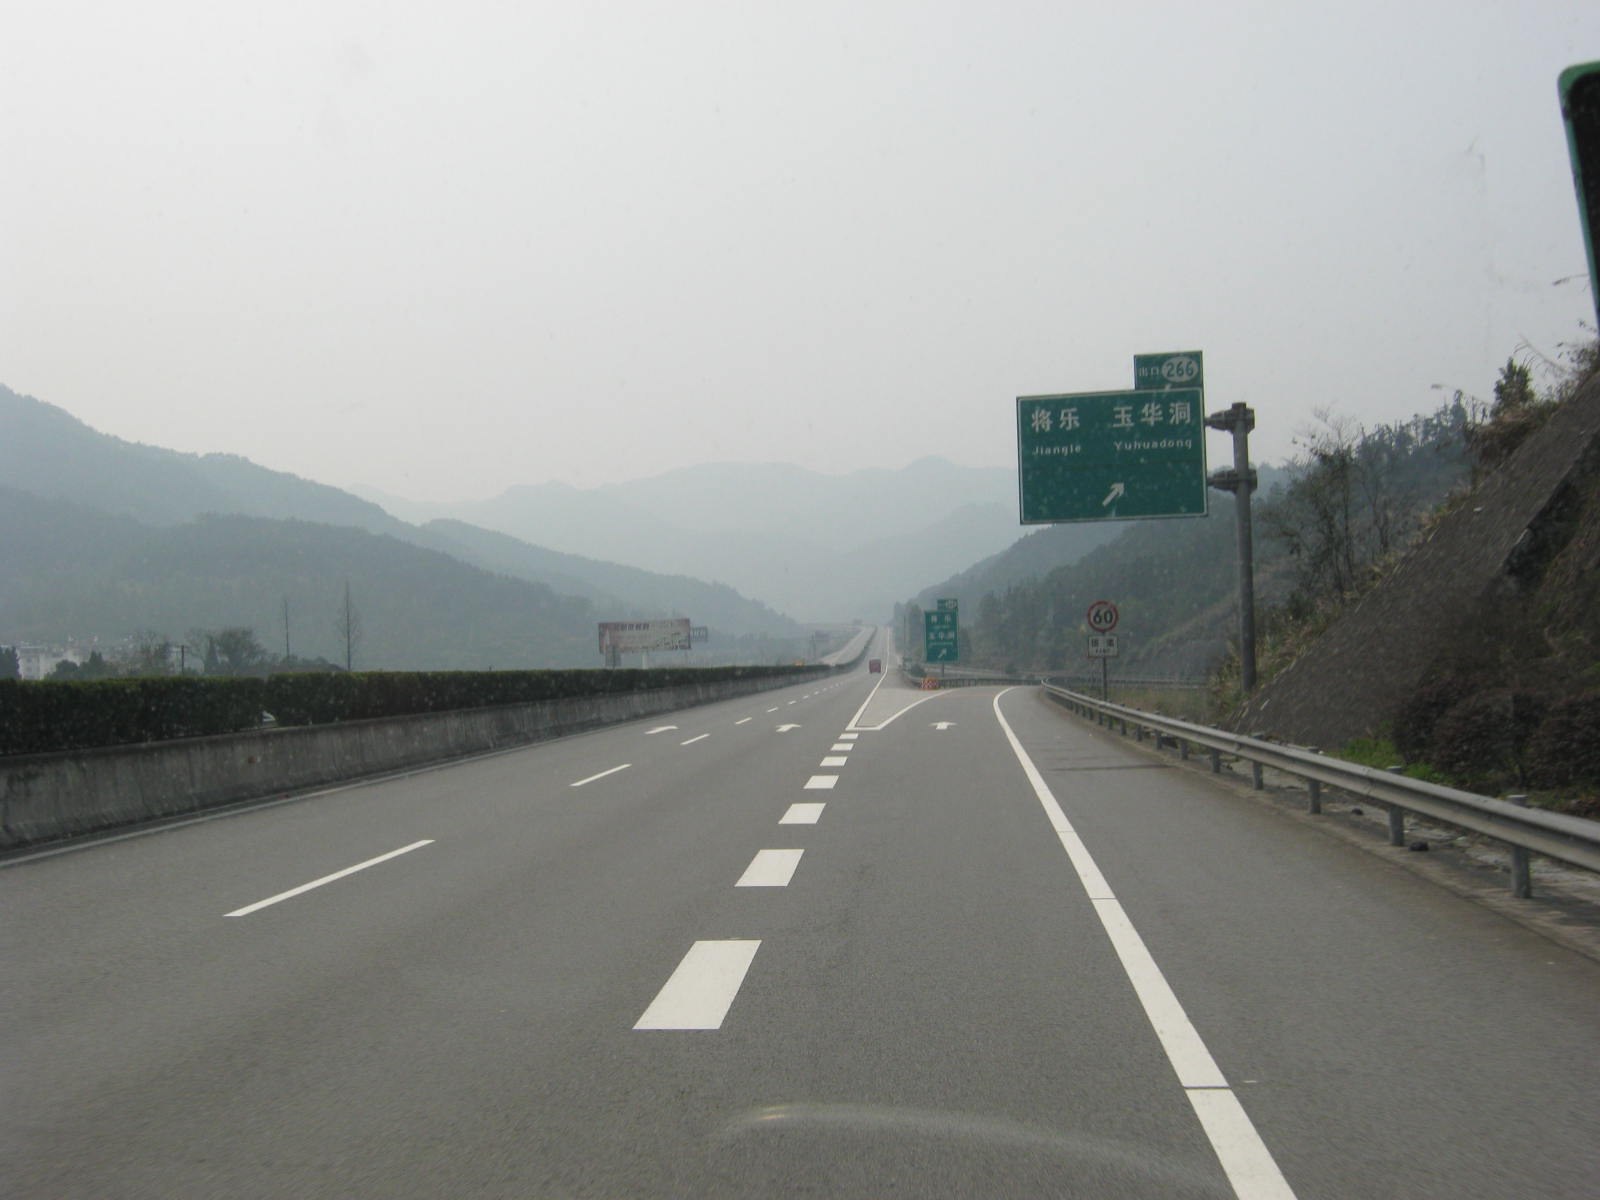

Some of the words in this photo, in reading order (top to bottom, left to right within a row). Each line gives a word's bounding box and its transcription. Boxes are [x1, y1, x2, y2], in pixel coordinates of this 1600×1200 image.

[1166, 361, 1195, 378] 266
[1031, 407, 1080, 433] 将乐
[1112, 401, 1191, 429] 玉华洞
[1032, 444, 1082, 456] Jiangle
[1113, 438, 1193, 451] Yuhuadong
[1093, 609, 1113, 625] 60
